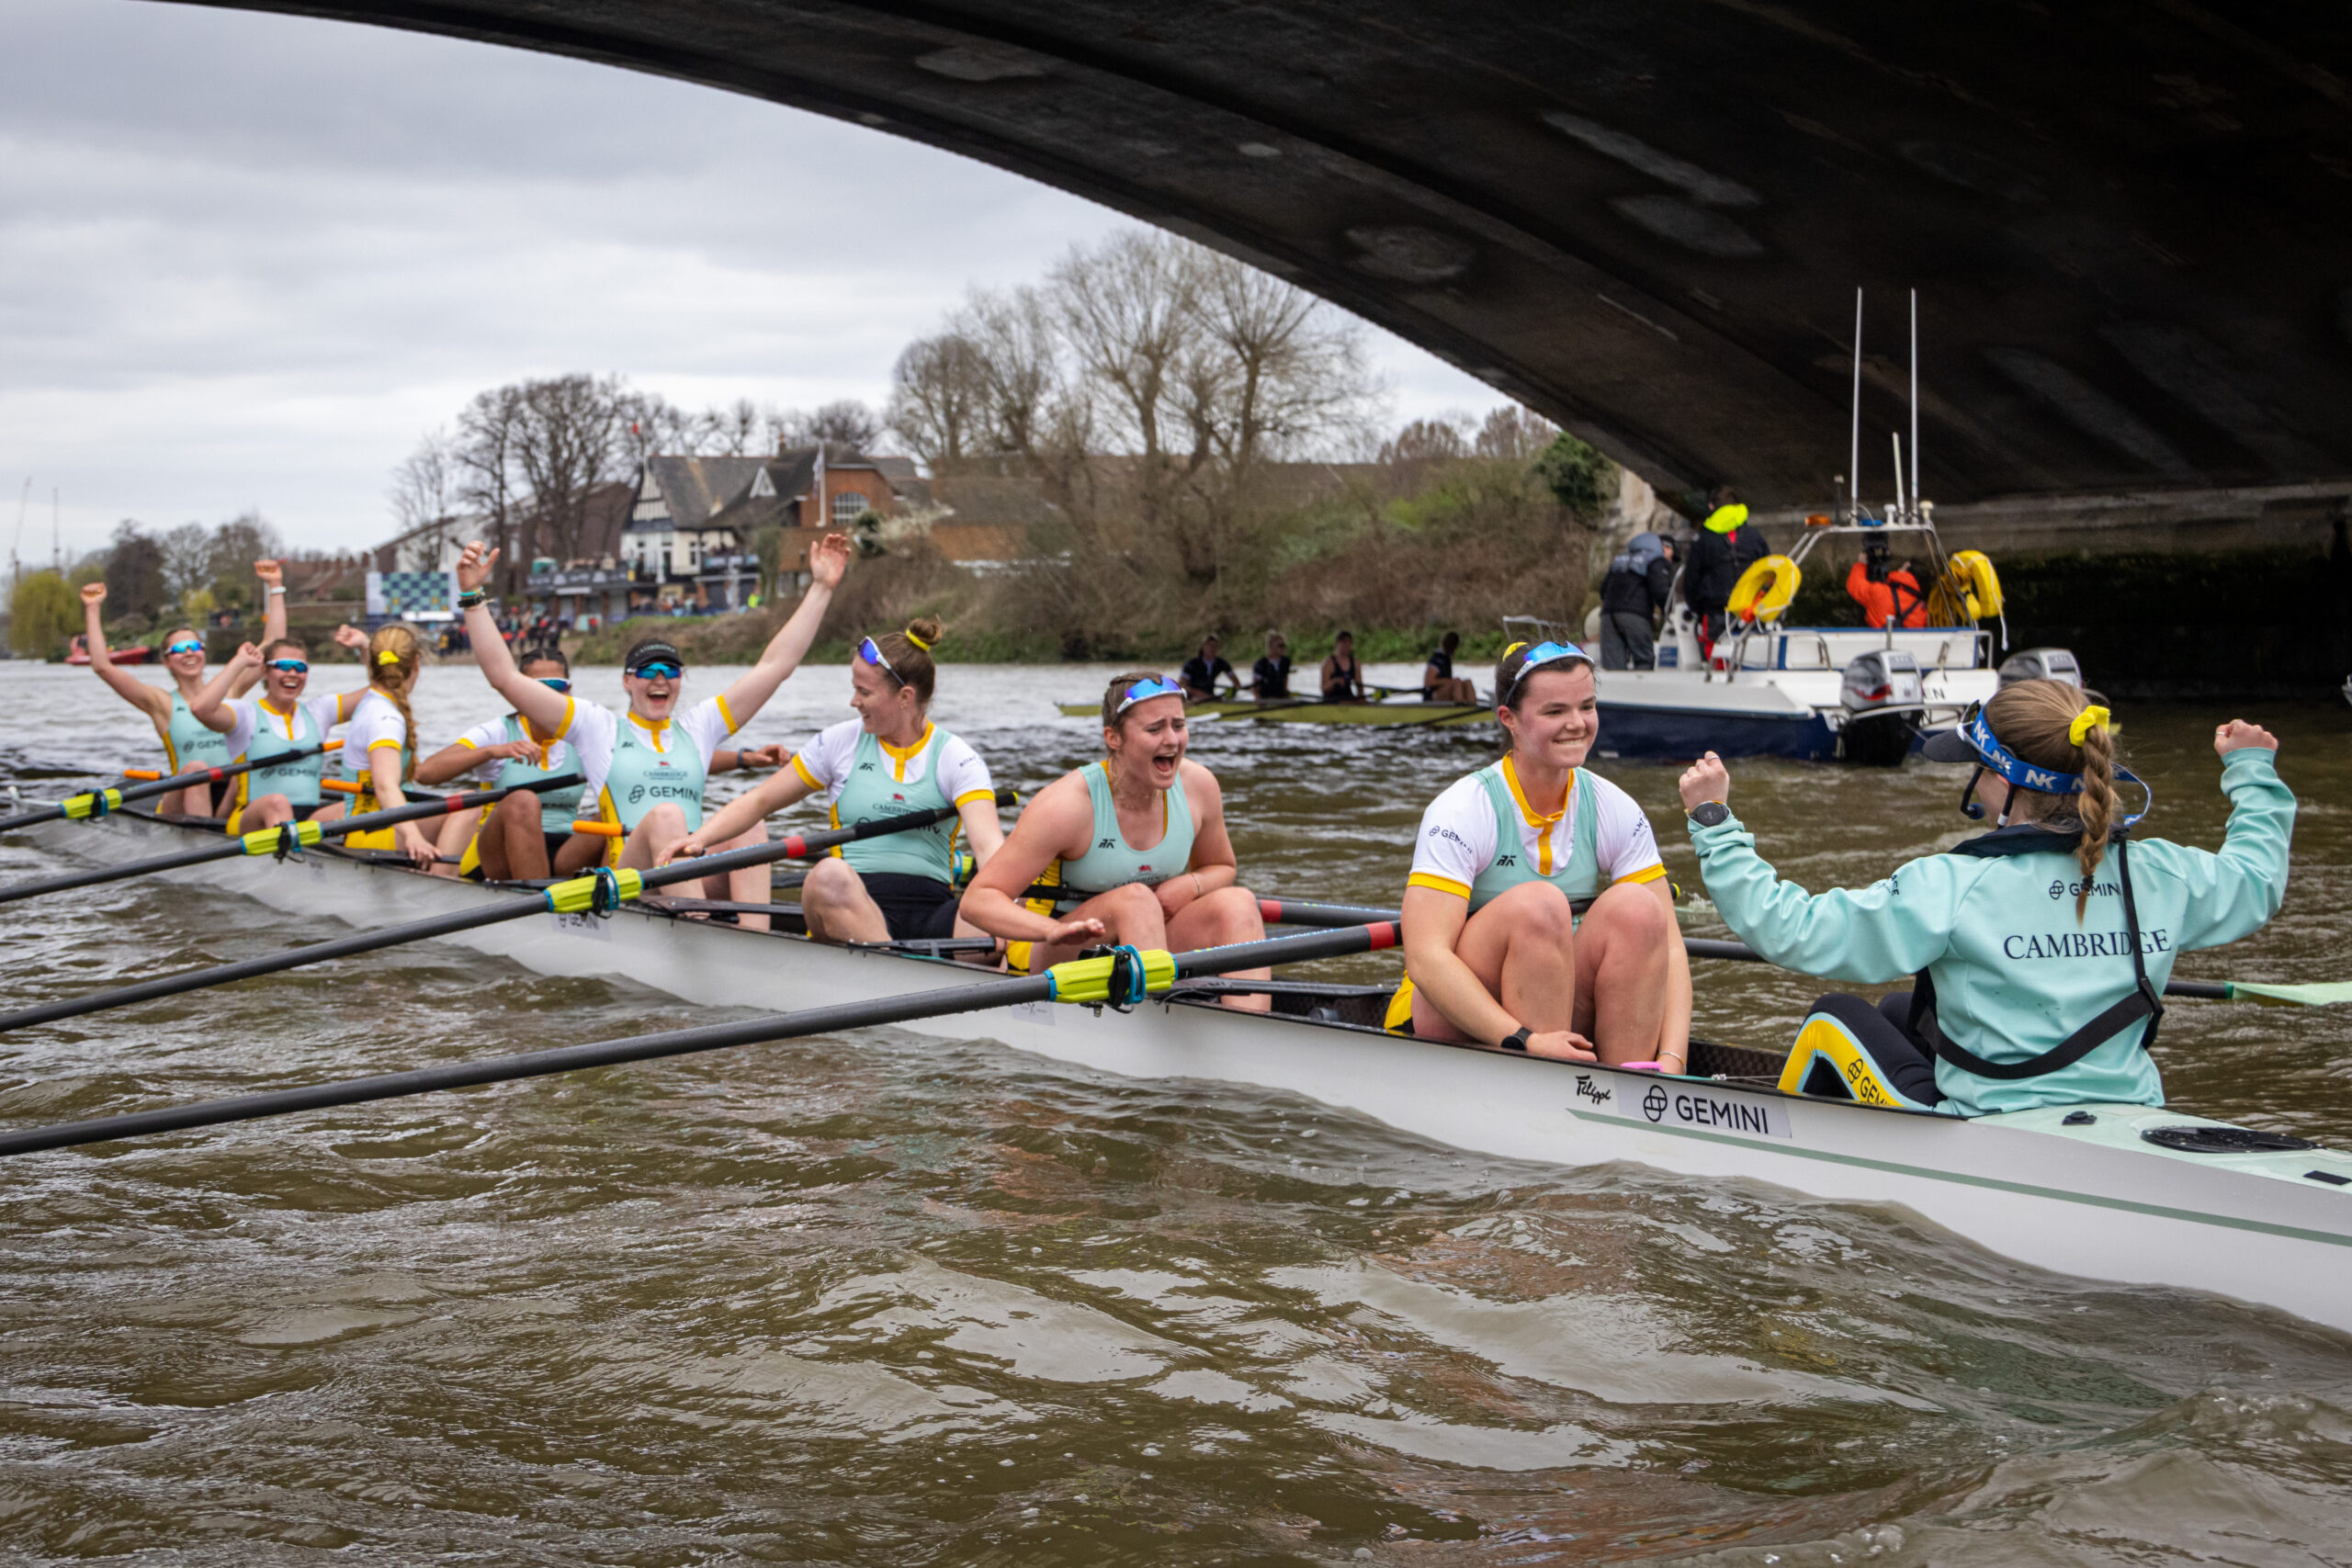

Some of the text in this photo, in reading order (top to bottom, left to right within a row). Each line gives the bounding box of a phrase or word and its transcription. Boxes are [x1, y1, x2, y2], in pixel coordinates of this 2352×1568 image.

[1973, 719, 1991, 750] NK
[2025, 769, 2058, 790] NK
[2070, 777, 2087, 791] N
[2003, 929, 2172, 960] CAMBRIDGE
[1575, 1074, 1611, 1106] Filippi
[1675, 1094, 1770, 1134] GEMINI
